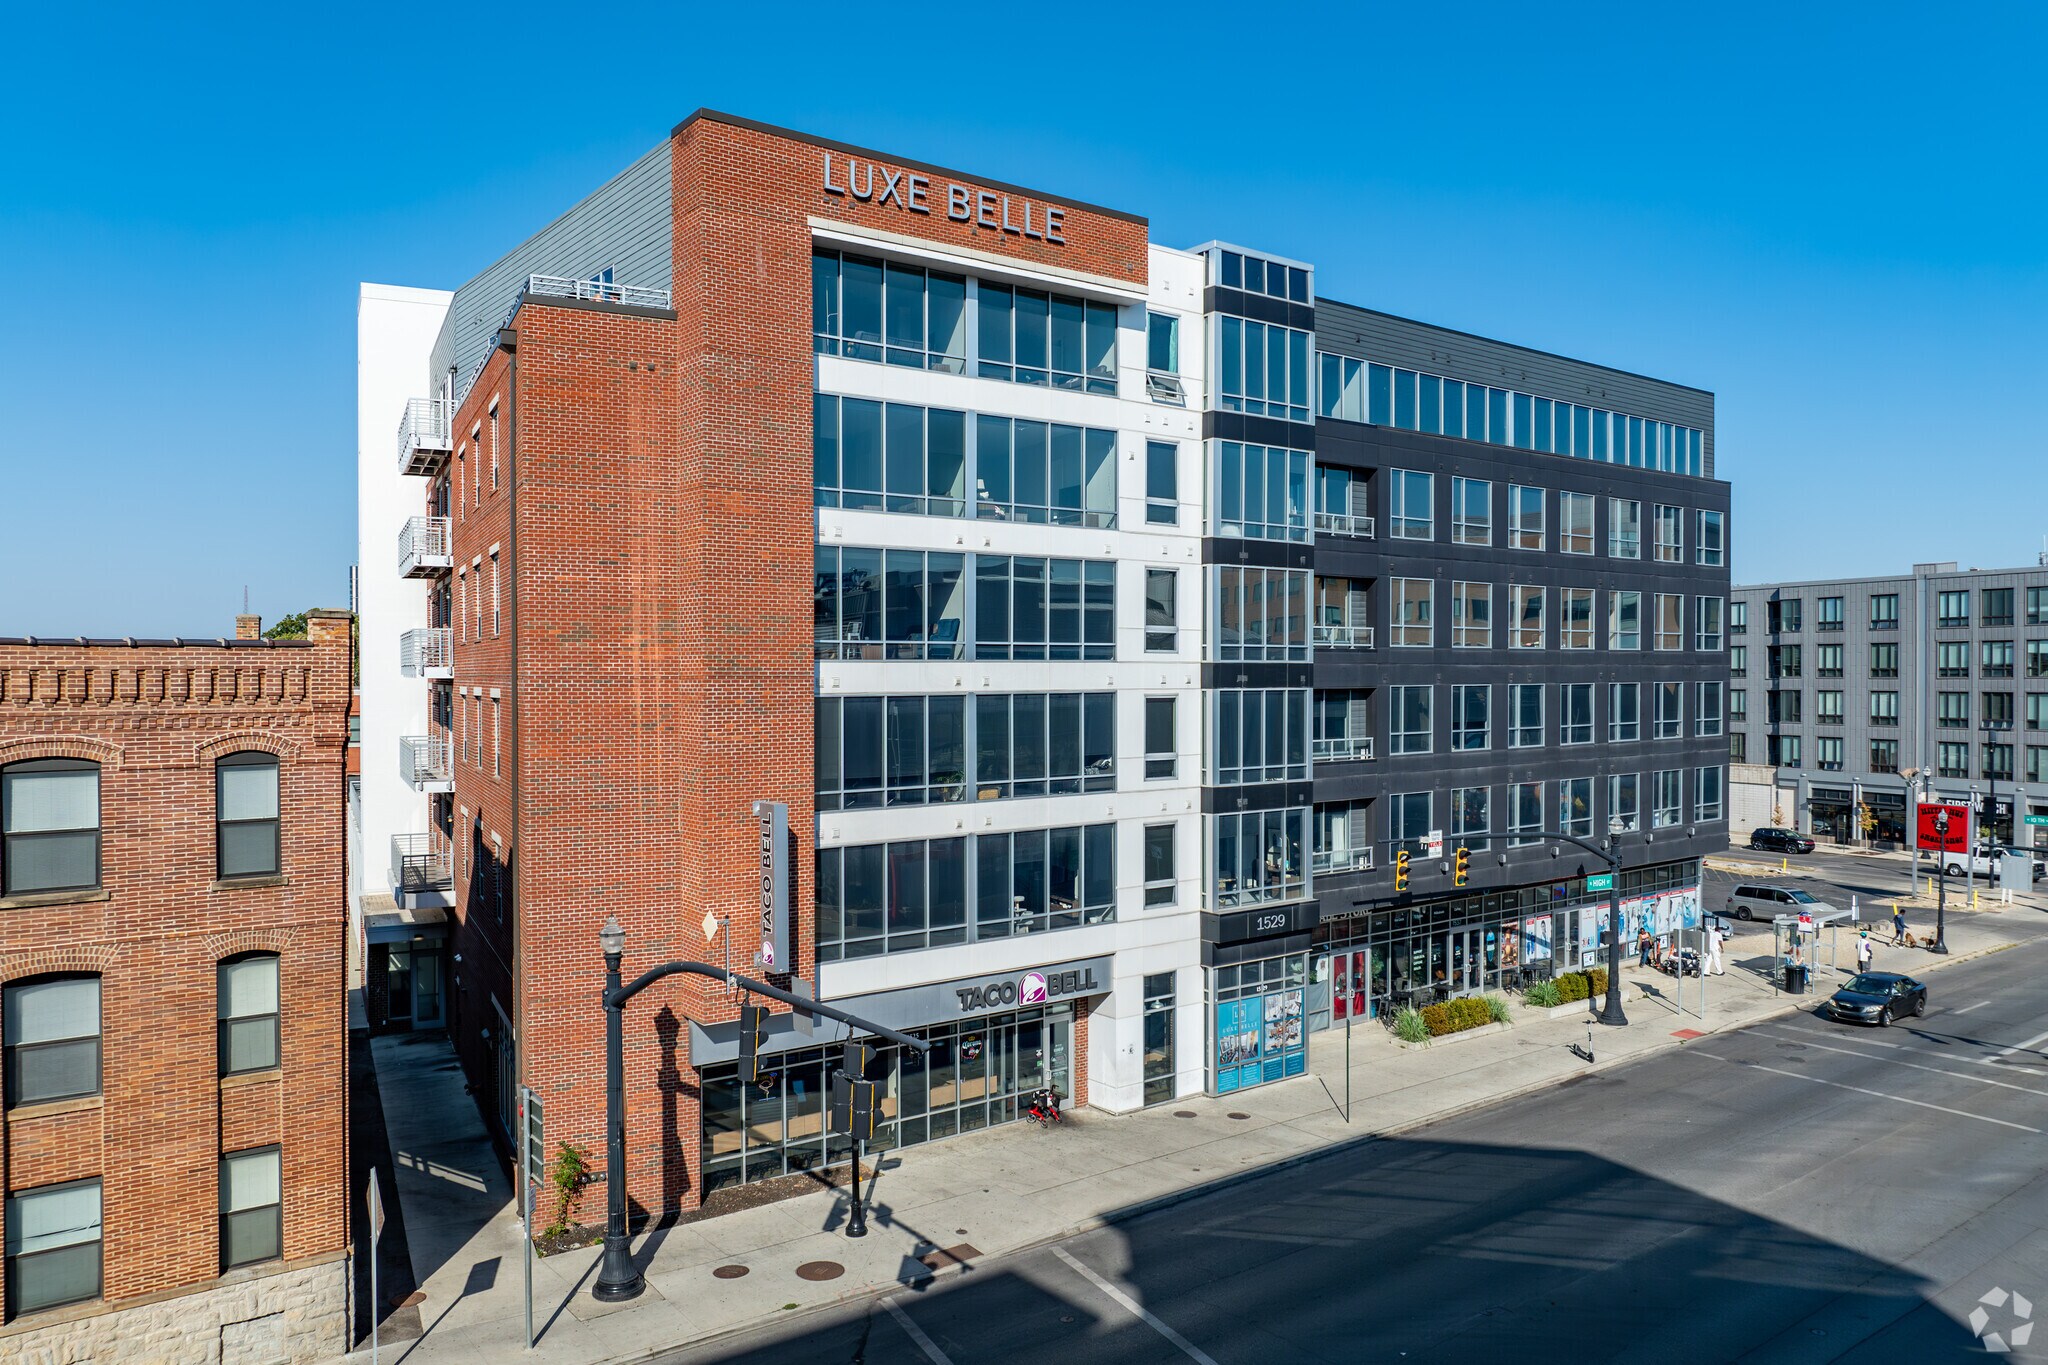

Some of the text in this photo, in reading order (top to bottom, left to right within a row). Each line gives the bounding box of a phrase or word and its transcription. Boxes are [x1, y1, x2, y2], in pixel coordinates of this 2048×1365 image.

[823, 153, 1065, 245] LUXE BELLE
[1974, 801, 2007, 814] WCH
[762, 812, 773, 937] TACO BELL
[1592, 878, 1606, 887] HIGH
[1257, 913, 1286, 930] 1529
[956, 967, 1098, 1012] TACO BELL
